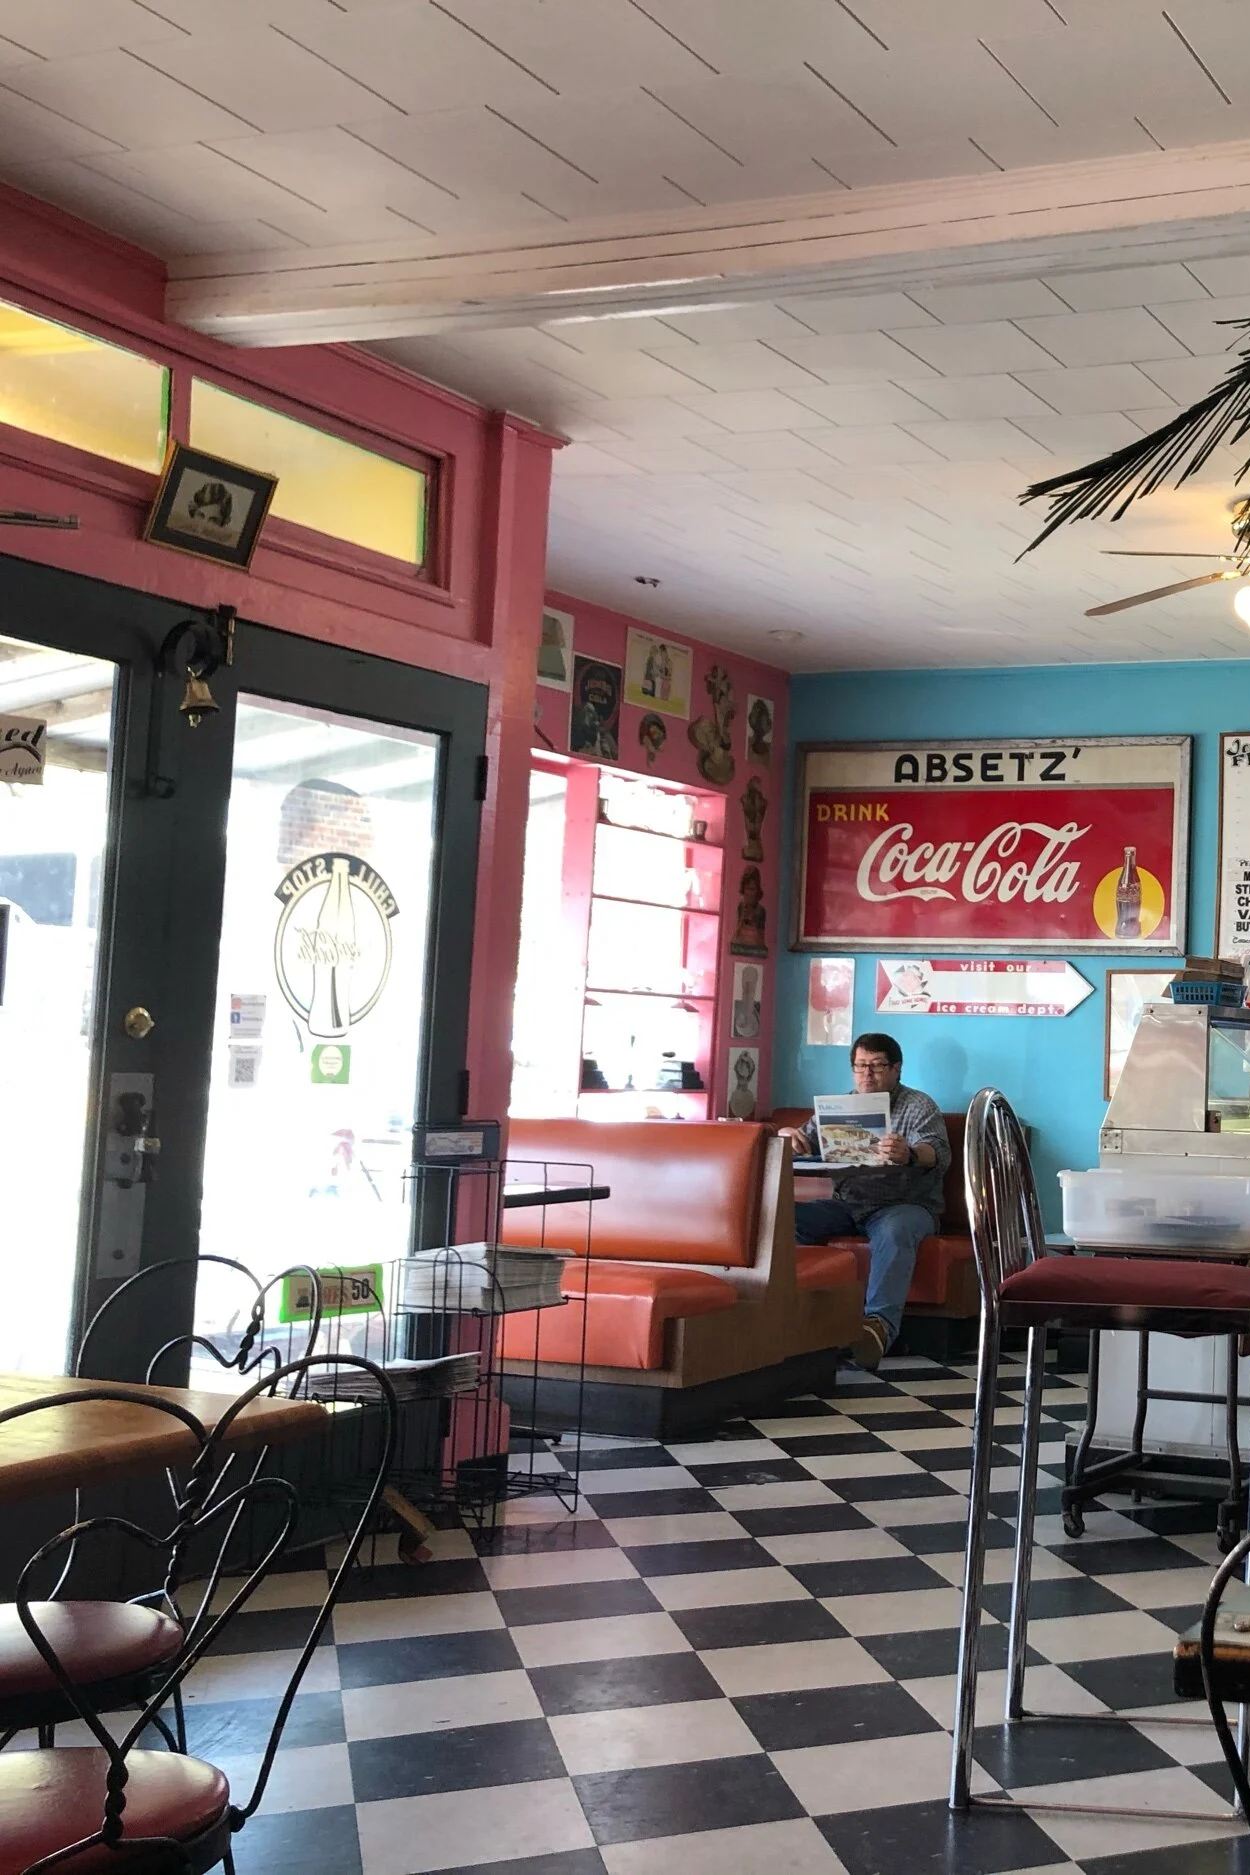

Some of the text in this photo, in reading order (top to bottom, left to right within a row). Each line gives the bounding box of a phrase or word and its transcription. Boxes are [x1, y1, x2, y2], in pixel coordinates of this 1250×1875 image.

[817, 803, 890, 823] DRINK
[857, 821, 1093, 904] Coca-Cola
[960, 961, 1032, 972] visit our
[936, 1002, 956, 1013] ice
[965, 1004, 1010, 1014] cream
[1018, 1003, 1059, 1015] dept.
